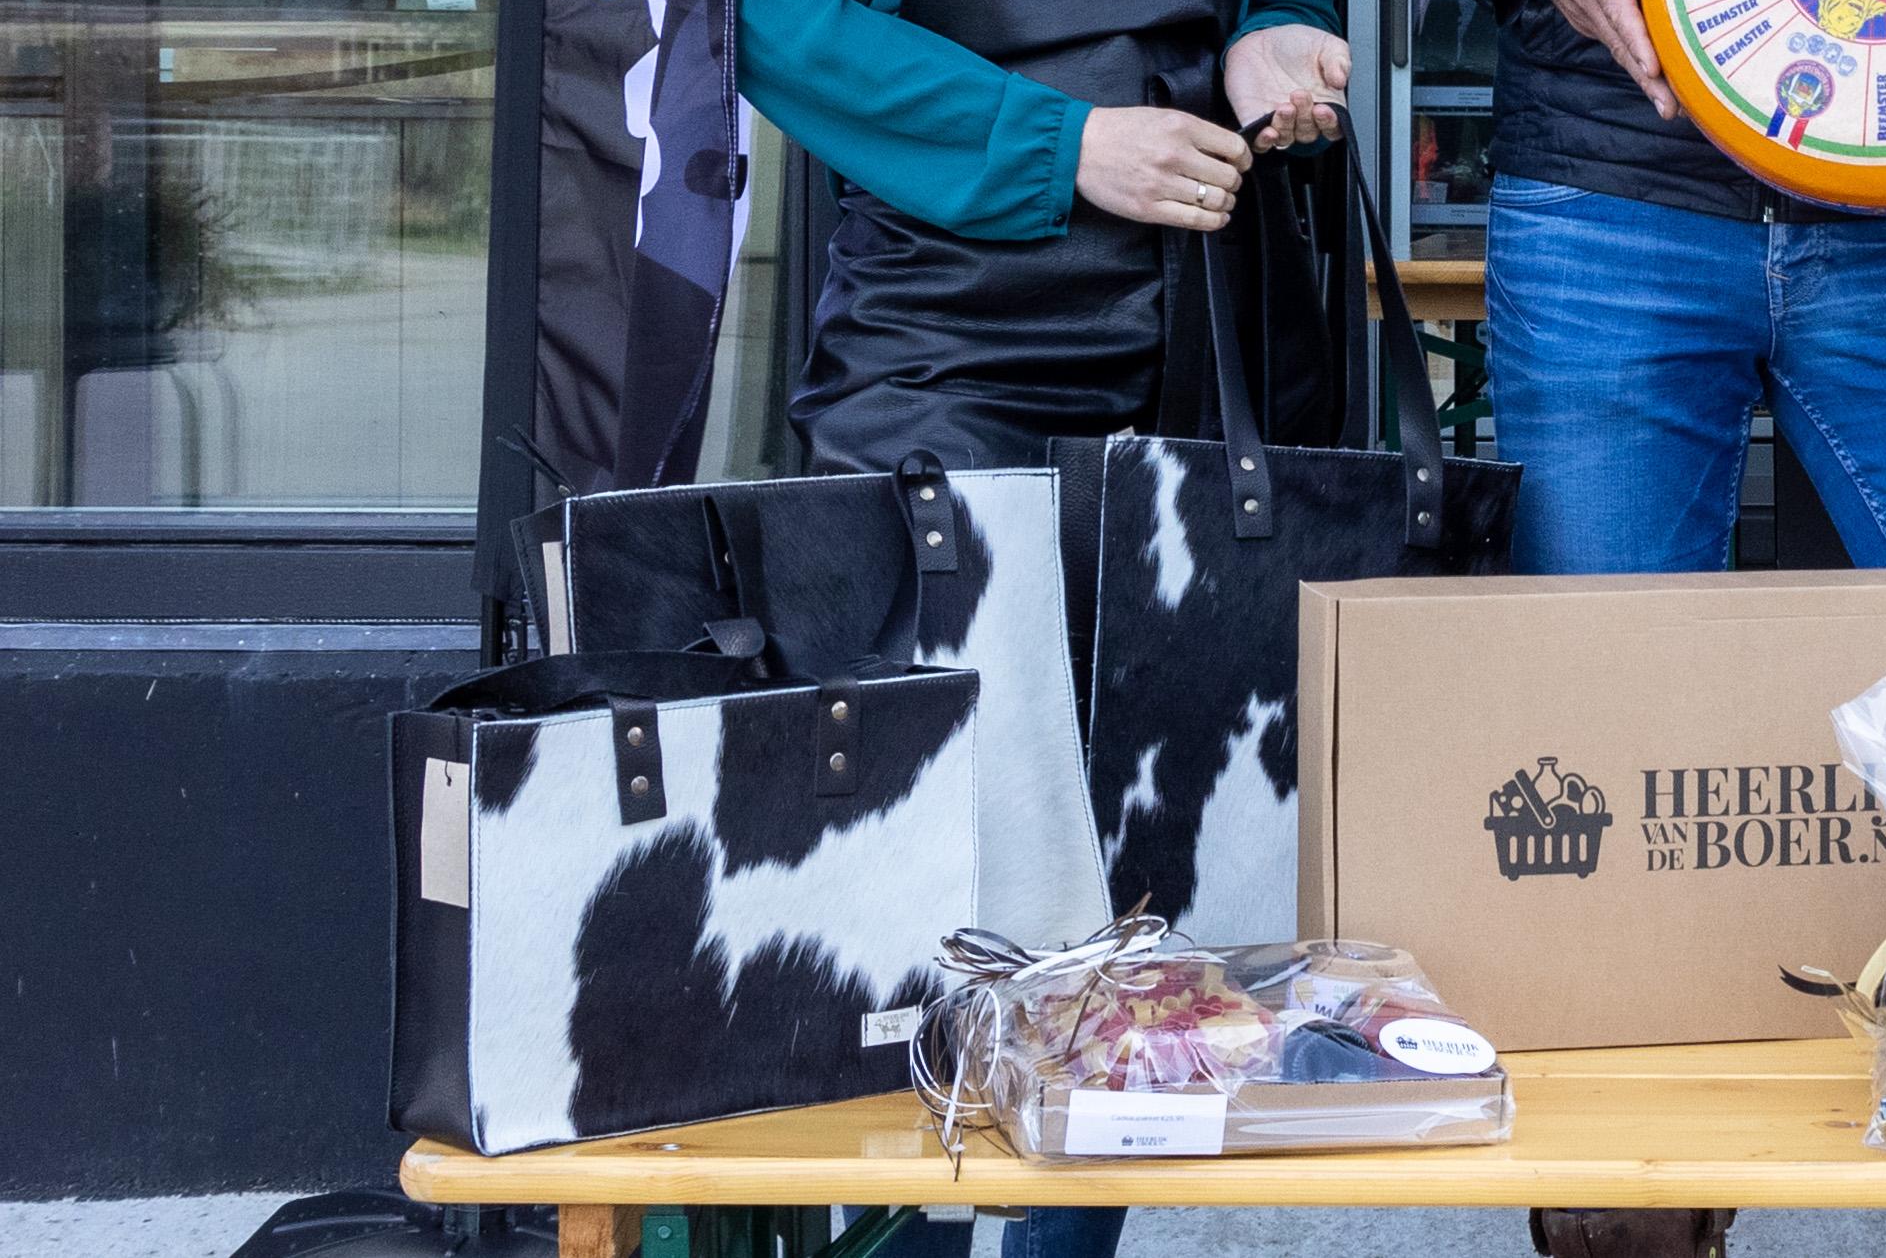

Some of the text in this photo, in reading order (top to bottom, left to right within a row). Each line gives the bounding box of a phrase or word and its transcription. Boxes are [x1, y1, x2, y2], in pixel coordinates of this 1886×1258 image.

[1714, 19, 1772, 66] BEEMSTER
[1642, 822, 1688, 844] VAN
[1647, 848, 1685, 871] DE
